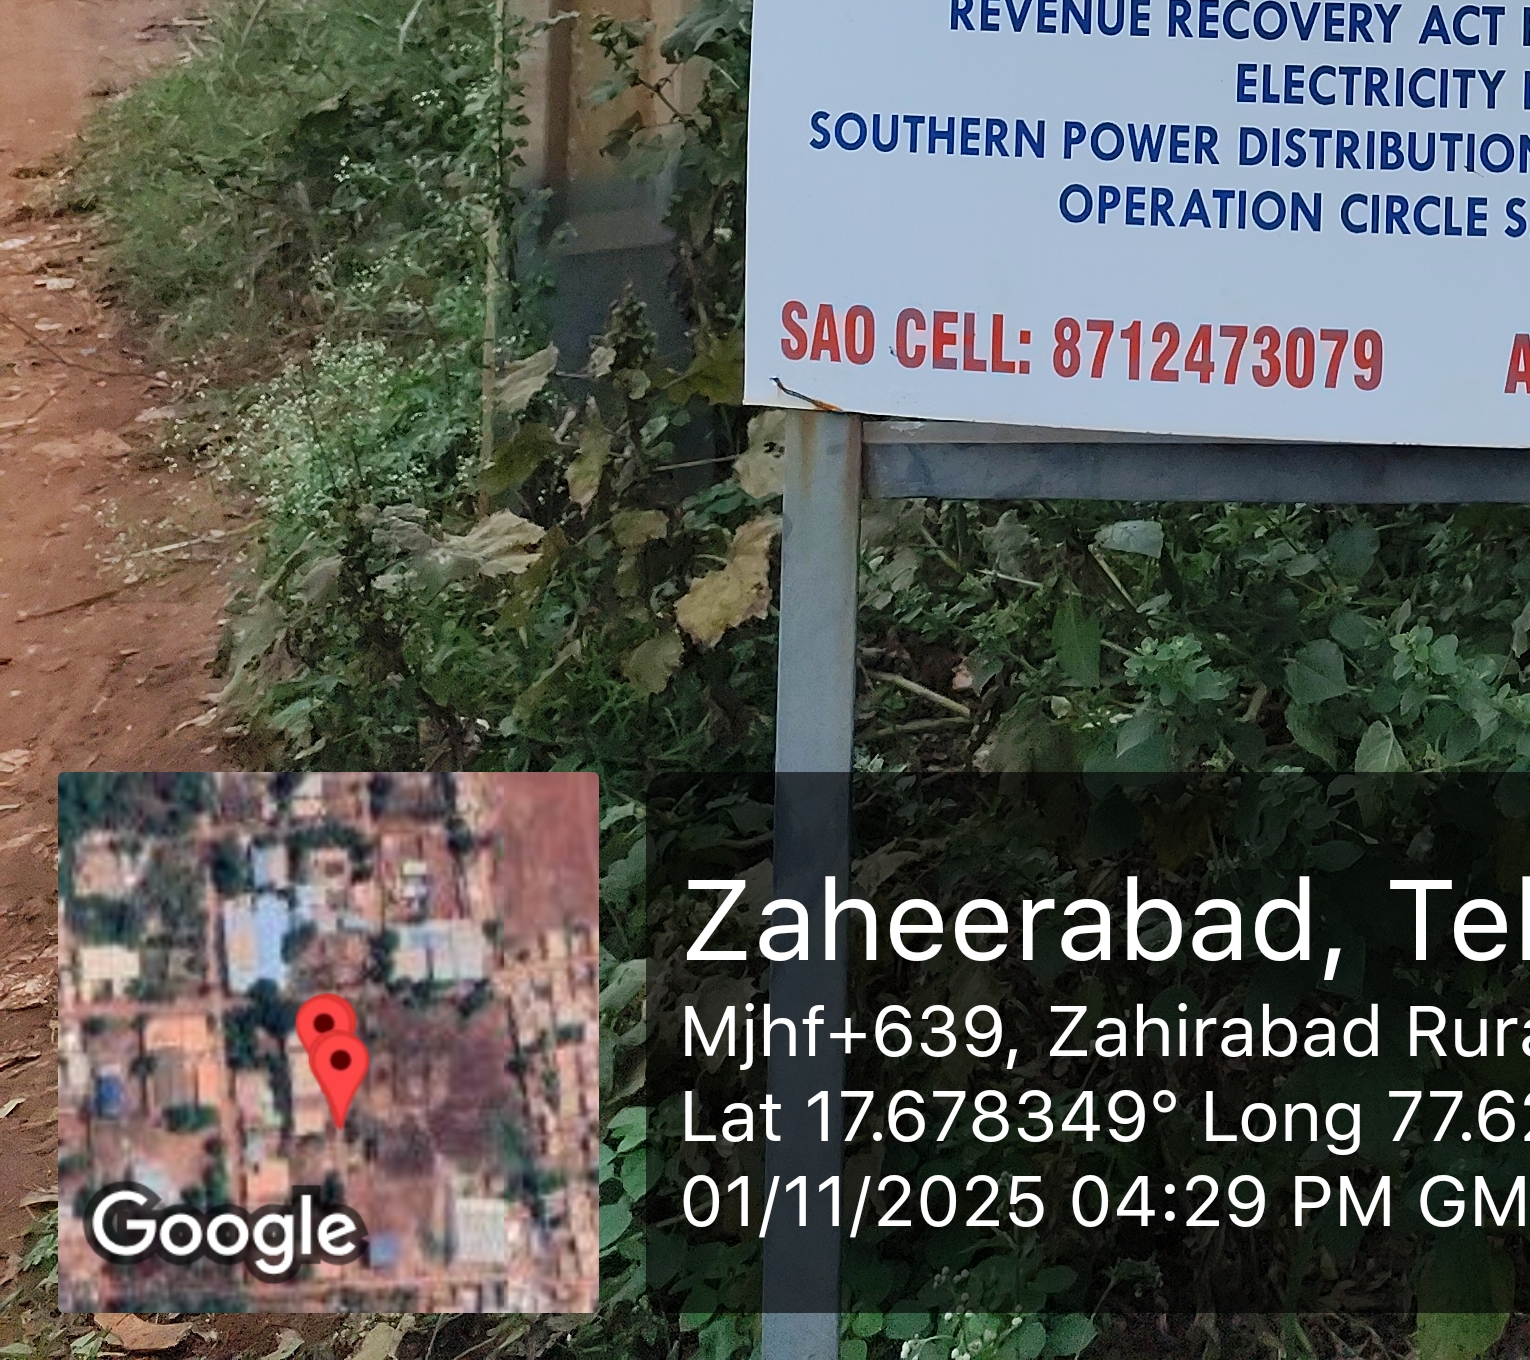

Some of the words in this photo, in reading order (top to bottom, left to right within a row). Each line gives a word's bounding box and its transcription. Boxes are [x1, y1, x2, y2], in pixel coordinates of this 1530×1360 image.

[1419, 5, 1505, 48] ACT
[1237, 63, 1505, 109] ELECTRICITY
[809, 111, 1045, 158] SOUTHERN
[1063, 121, 1219, 165] POWER
[1059, 183, 1321, 232] OPERATION
[1340, 194, 1487, 237] CIRCLE
[780, 300, 875, 365] SAO
[897, 308, 1030, 374] CELL:
[1053, 317, 1383, 391] 8712473079
